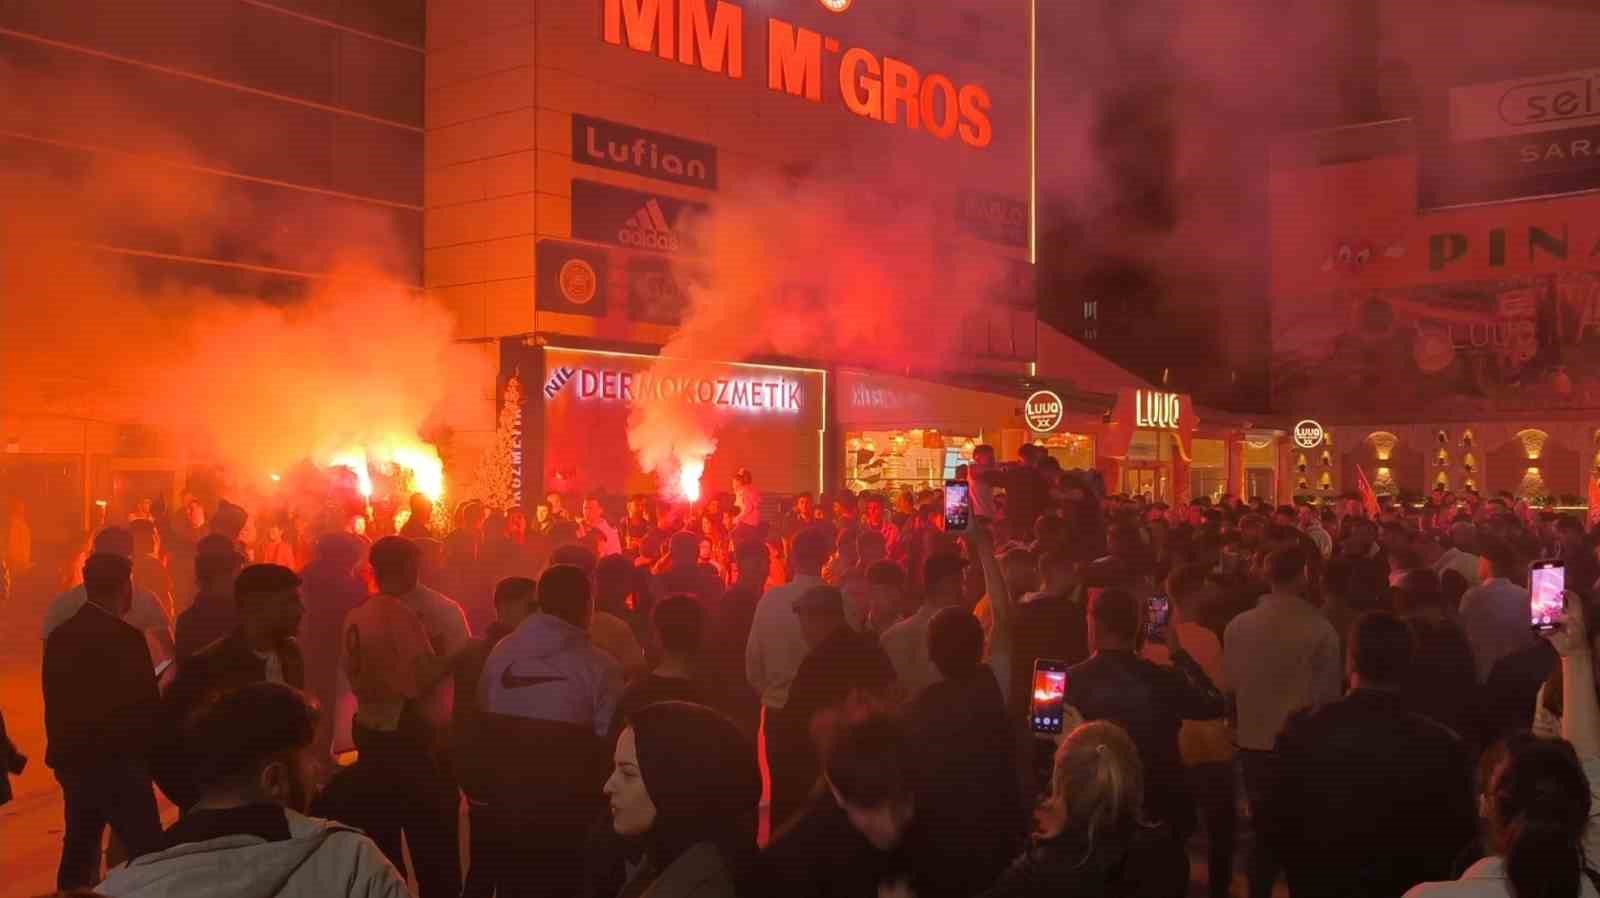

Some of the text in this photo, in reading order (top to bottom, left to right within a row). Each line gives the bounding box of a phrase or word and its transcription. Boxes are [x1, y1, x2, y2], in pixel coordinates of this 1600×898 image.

[603, 0, 992, 148] MM MGROS
[1528, 79, 1600, 119] sel
[586, 126, 705, 179] Lufian
[618, 228, 678, 250] adidas
[1429, 224, 1600, 272] PIN
